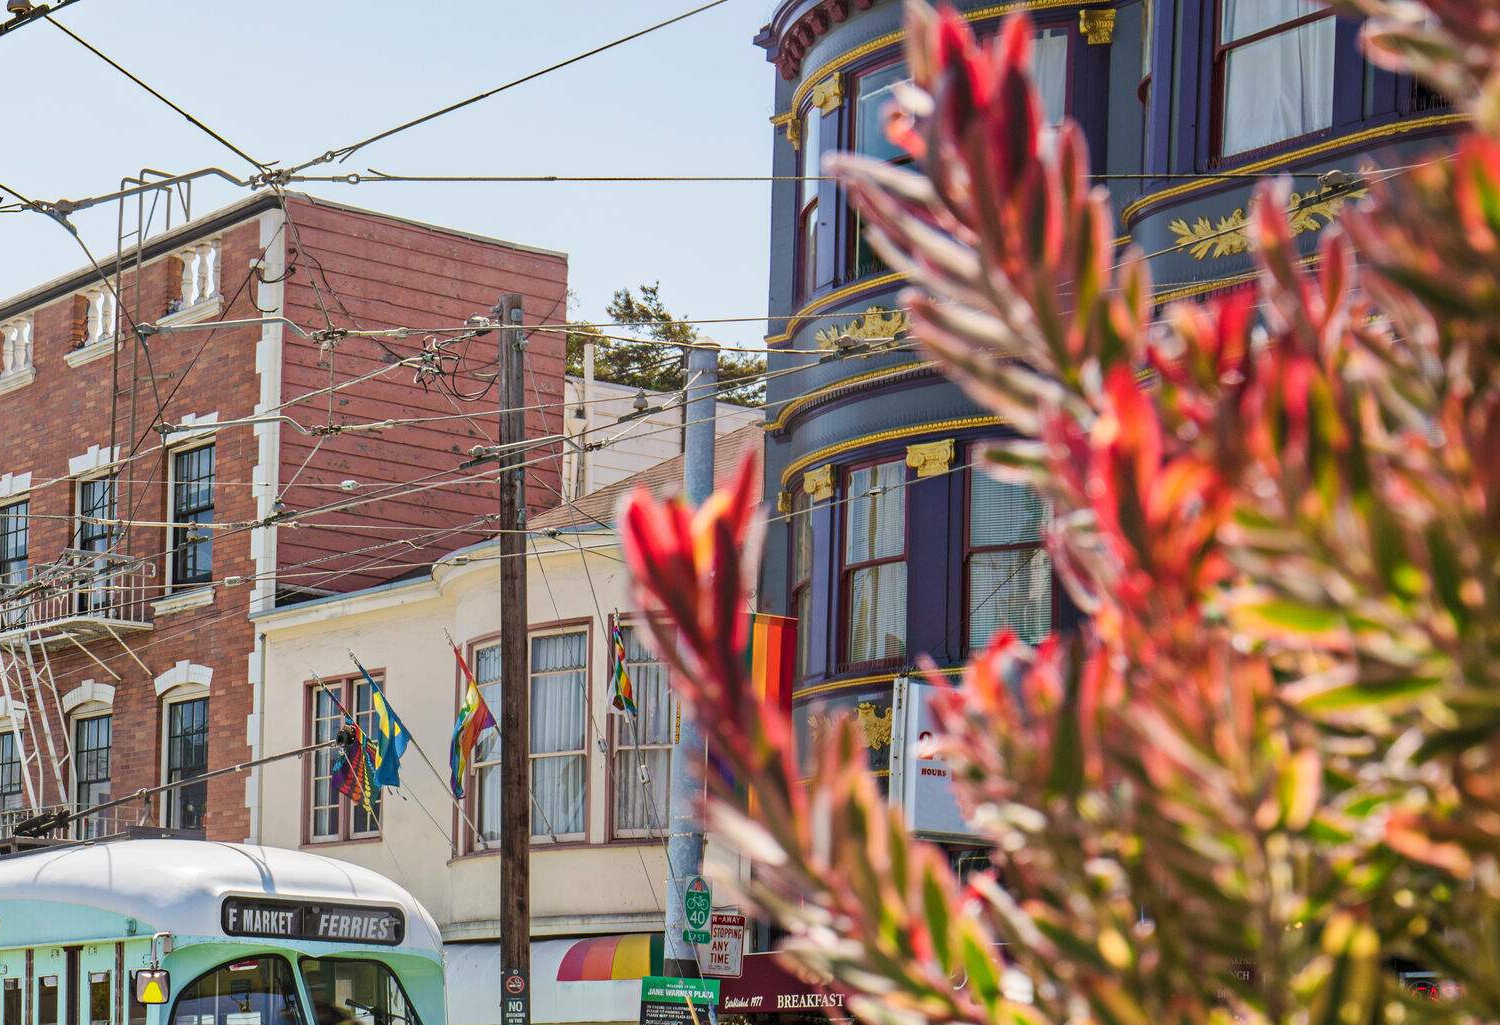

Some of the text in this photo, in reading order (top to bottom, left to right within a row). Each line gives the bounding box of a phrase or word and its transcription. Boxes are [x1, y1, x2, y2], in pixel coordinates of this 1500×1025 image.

[921, 768, 947, 777] HOURS
[228, 908, 294, 934] F MARKET
[690, 911, 705, 924] 40
[318, 914, 390, 939] FERRIES
[713, 927, 742, 939] STOPPING
[712, 941, 729, 951] ANY
[710, 953, 730, 964] TIME
[648, 988, 664, 996] JANE
[694, 990, 714, 999] PLAZA
[508, 1001, 523, 1011] NO
[750, 996, 764, 1007] 1977
[777, 993, 845, 1009] BREAKFAST
